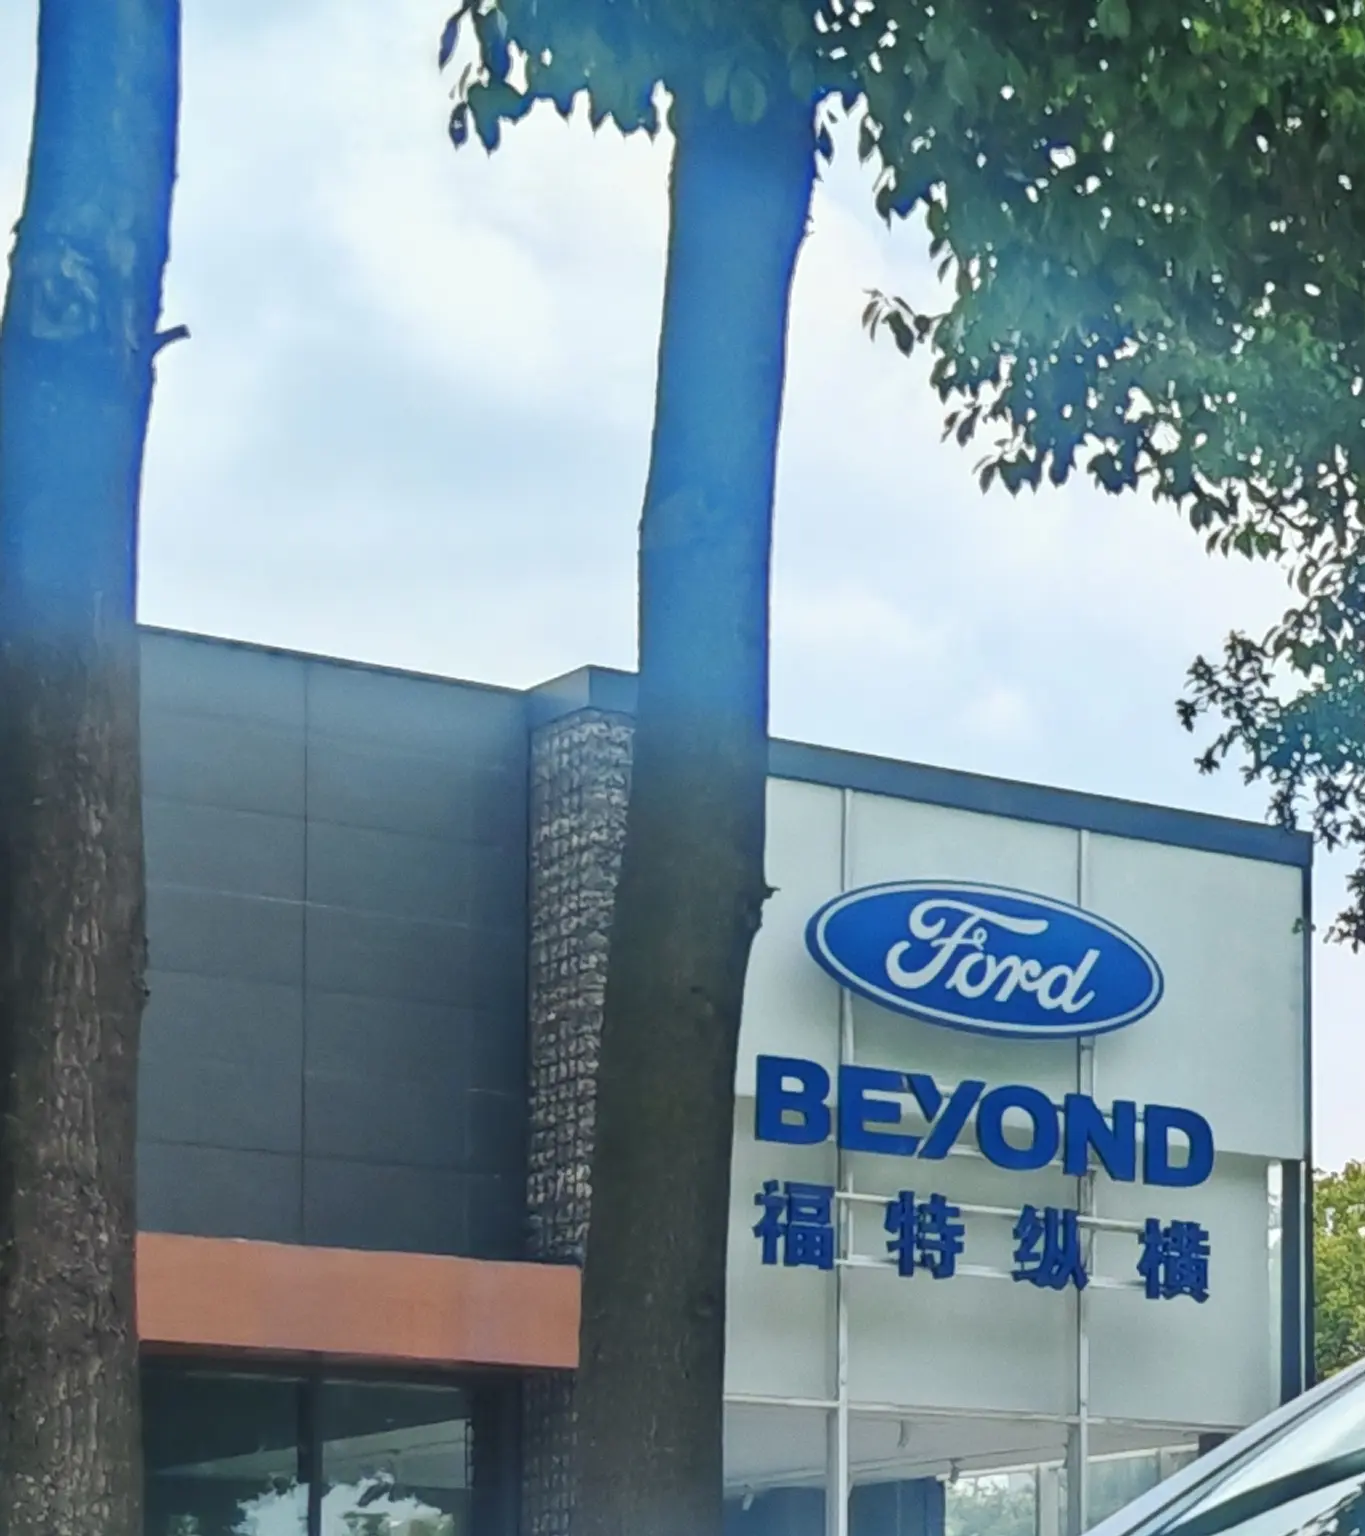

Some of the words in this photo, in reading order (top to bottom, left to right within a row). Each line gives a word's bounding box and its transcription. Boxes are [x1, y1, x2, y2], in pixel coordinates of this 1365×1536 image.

[885, 898, 1101, 1014] Ford
[755, 1054, 1215, 1188] BEYOND
[752, 1179, 1211, 1304] 福特纵横
